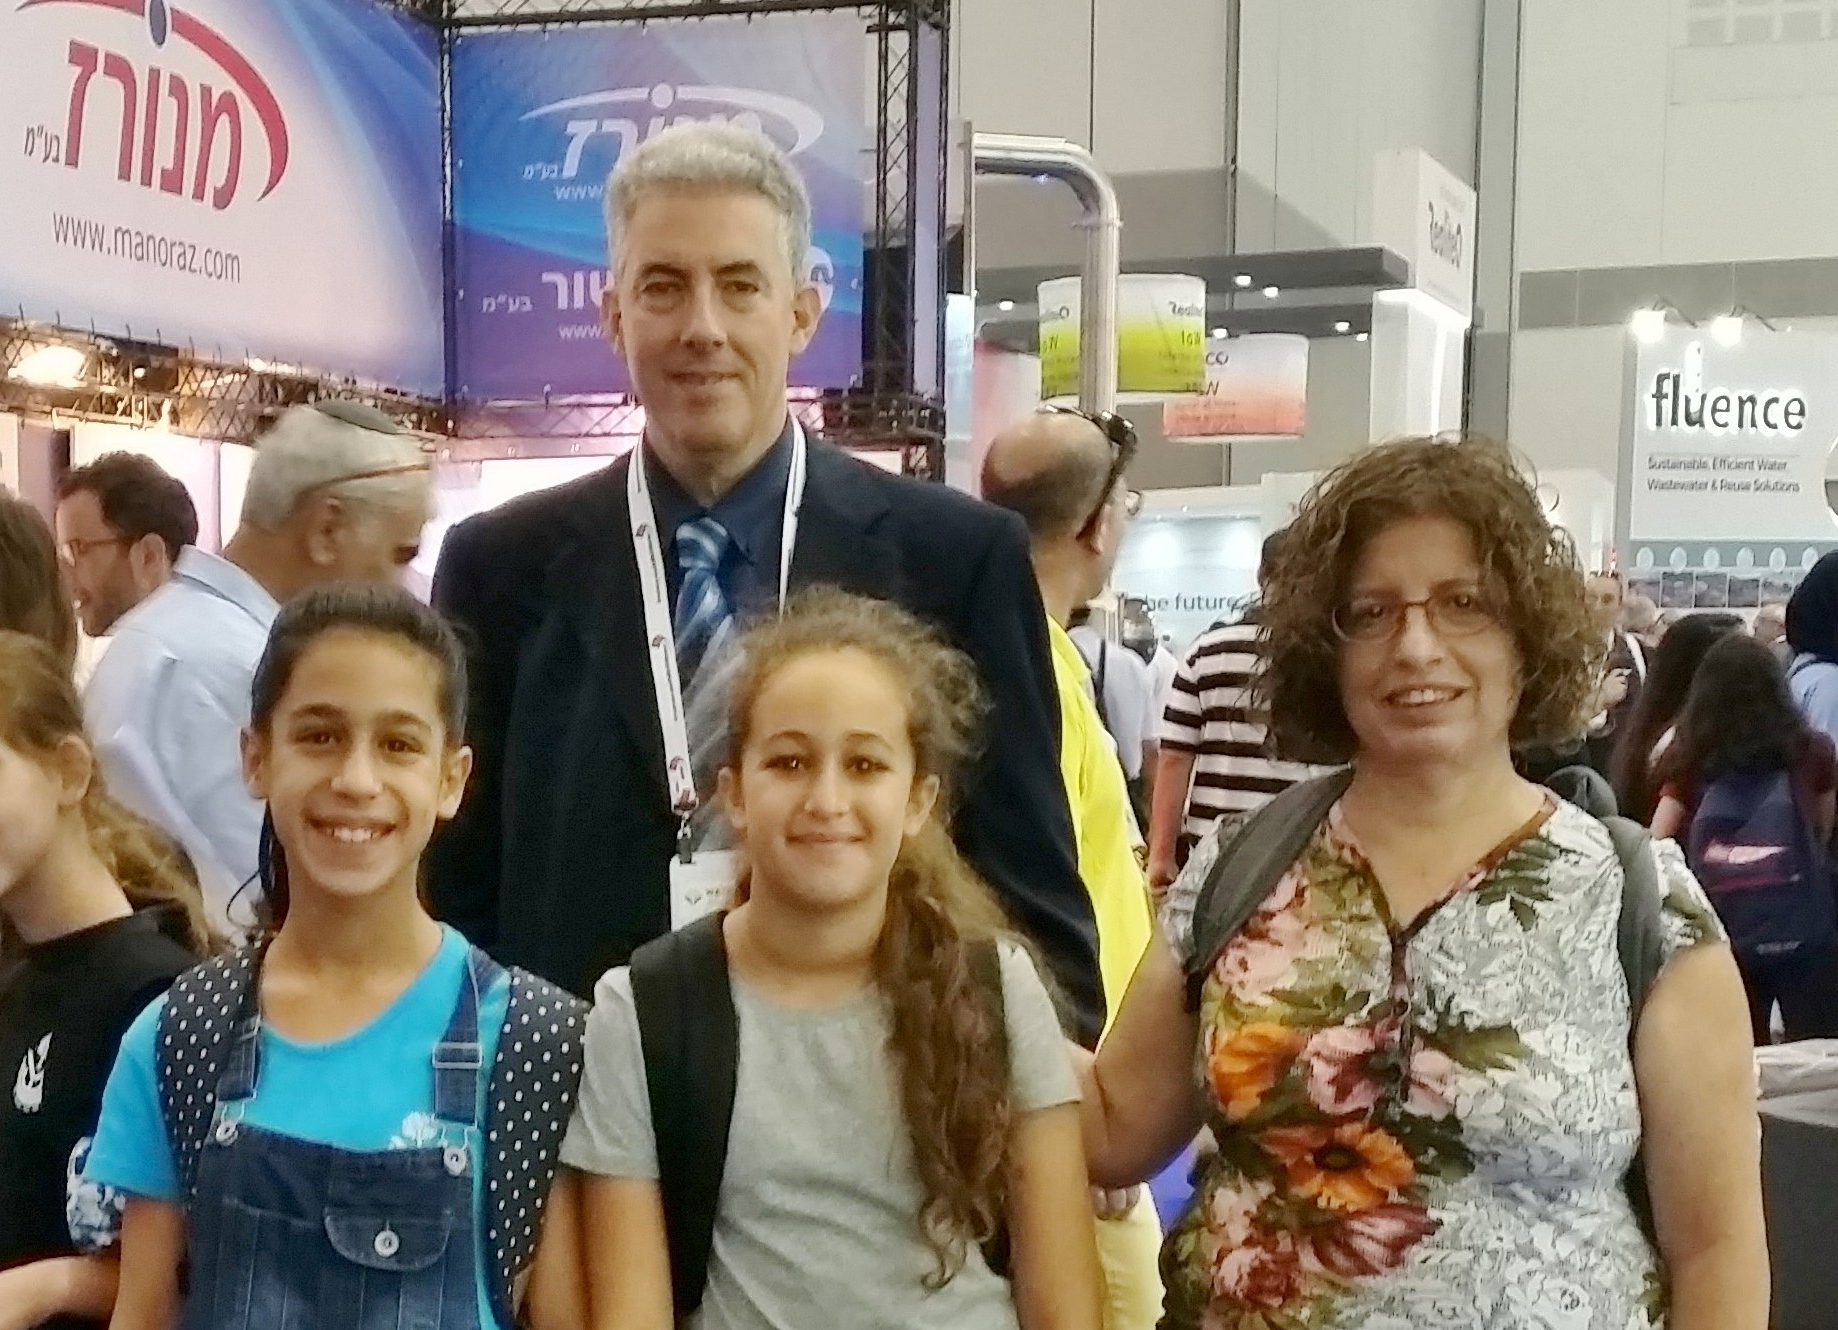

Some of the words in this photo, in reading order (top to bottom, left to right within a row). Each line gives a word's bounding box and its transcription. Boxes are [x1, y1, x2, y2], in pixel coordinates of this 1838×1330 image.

[64, 39, 242, 211] מנורז
[52, 211, 241, 283] www.manoraz.com
[1650, 371, 1807, 431] fluence
